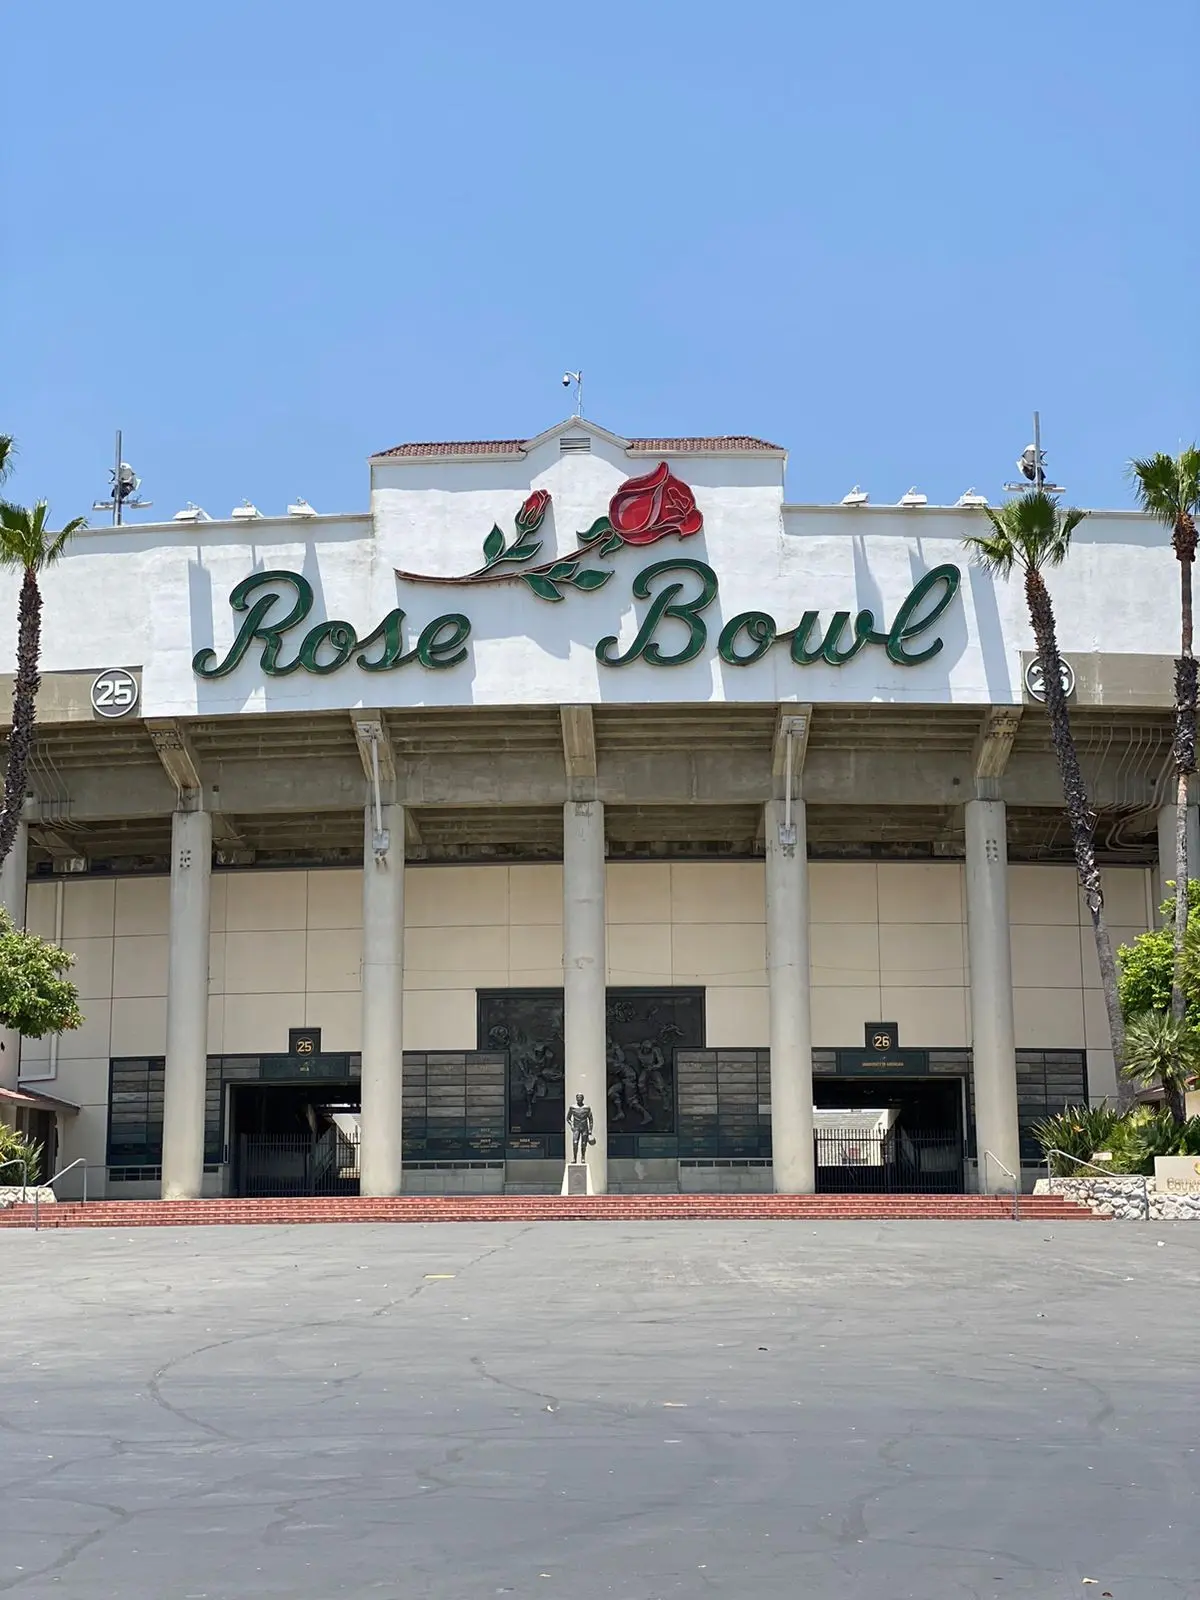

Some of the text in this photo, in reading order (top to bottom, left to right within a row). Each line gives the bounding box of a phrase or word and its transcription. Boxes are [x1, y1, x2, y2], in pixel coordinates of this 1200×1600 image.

[193, 557, 962, 679] Rose Bowl
[96, 680, 132, 705] 25
[297, 1041, 312, 1052] 25
[874, 1035, 890, 1047] 26
